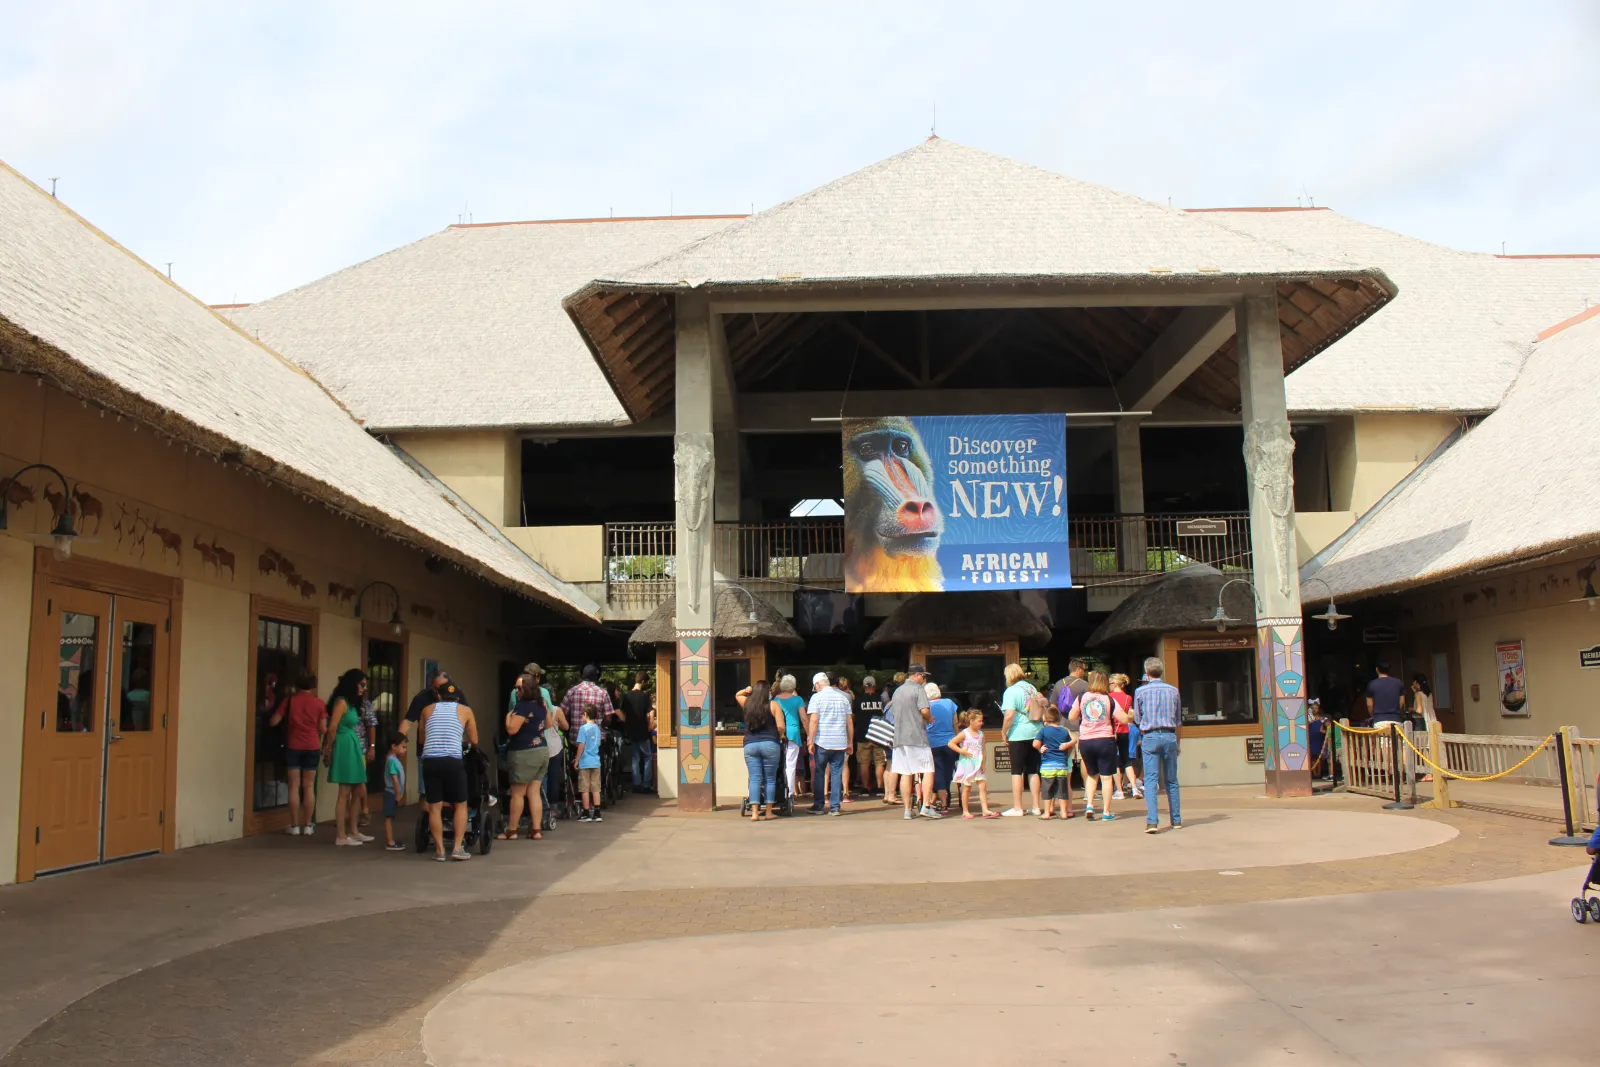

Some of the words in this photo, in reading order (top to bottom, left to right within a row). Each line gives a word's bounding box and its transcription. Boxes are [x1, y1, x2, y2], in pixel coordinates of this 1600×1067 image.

[948, 436, 1037, 455] Discover
[948, 456, 1052, 477] something
[949, 475, 1064, 519] NEW!
[961, 552, 1049, 571] AFRICAN
[971, 571, 1041, 584] FOREST
